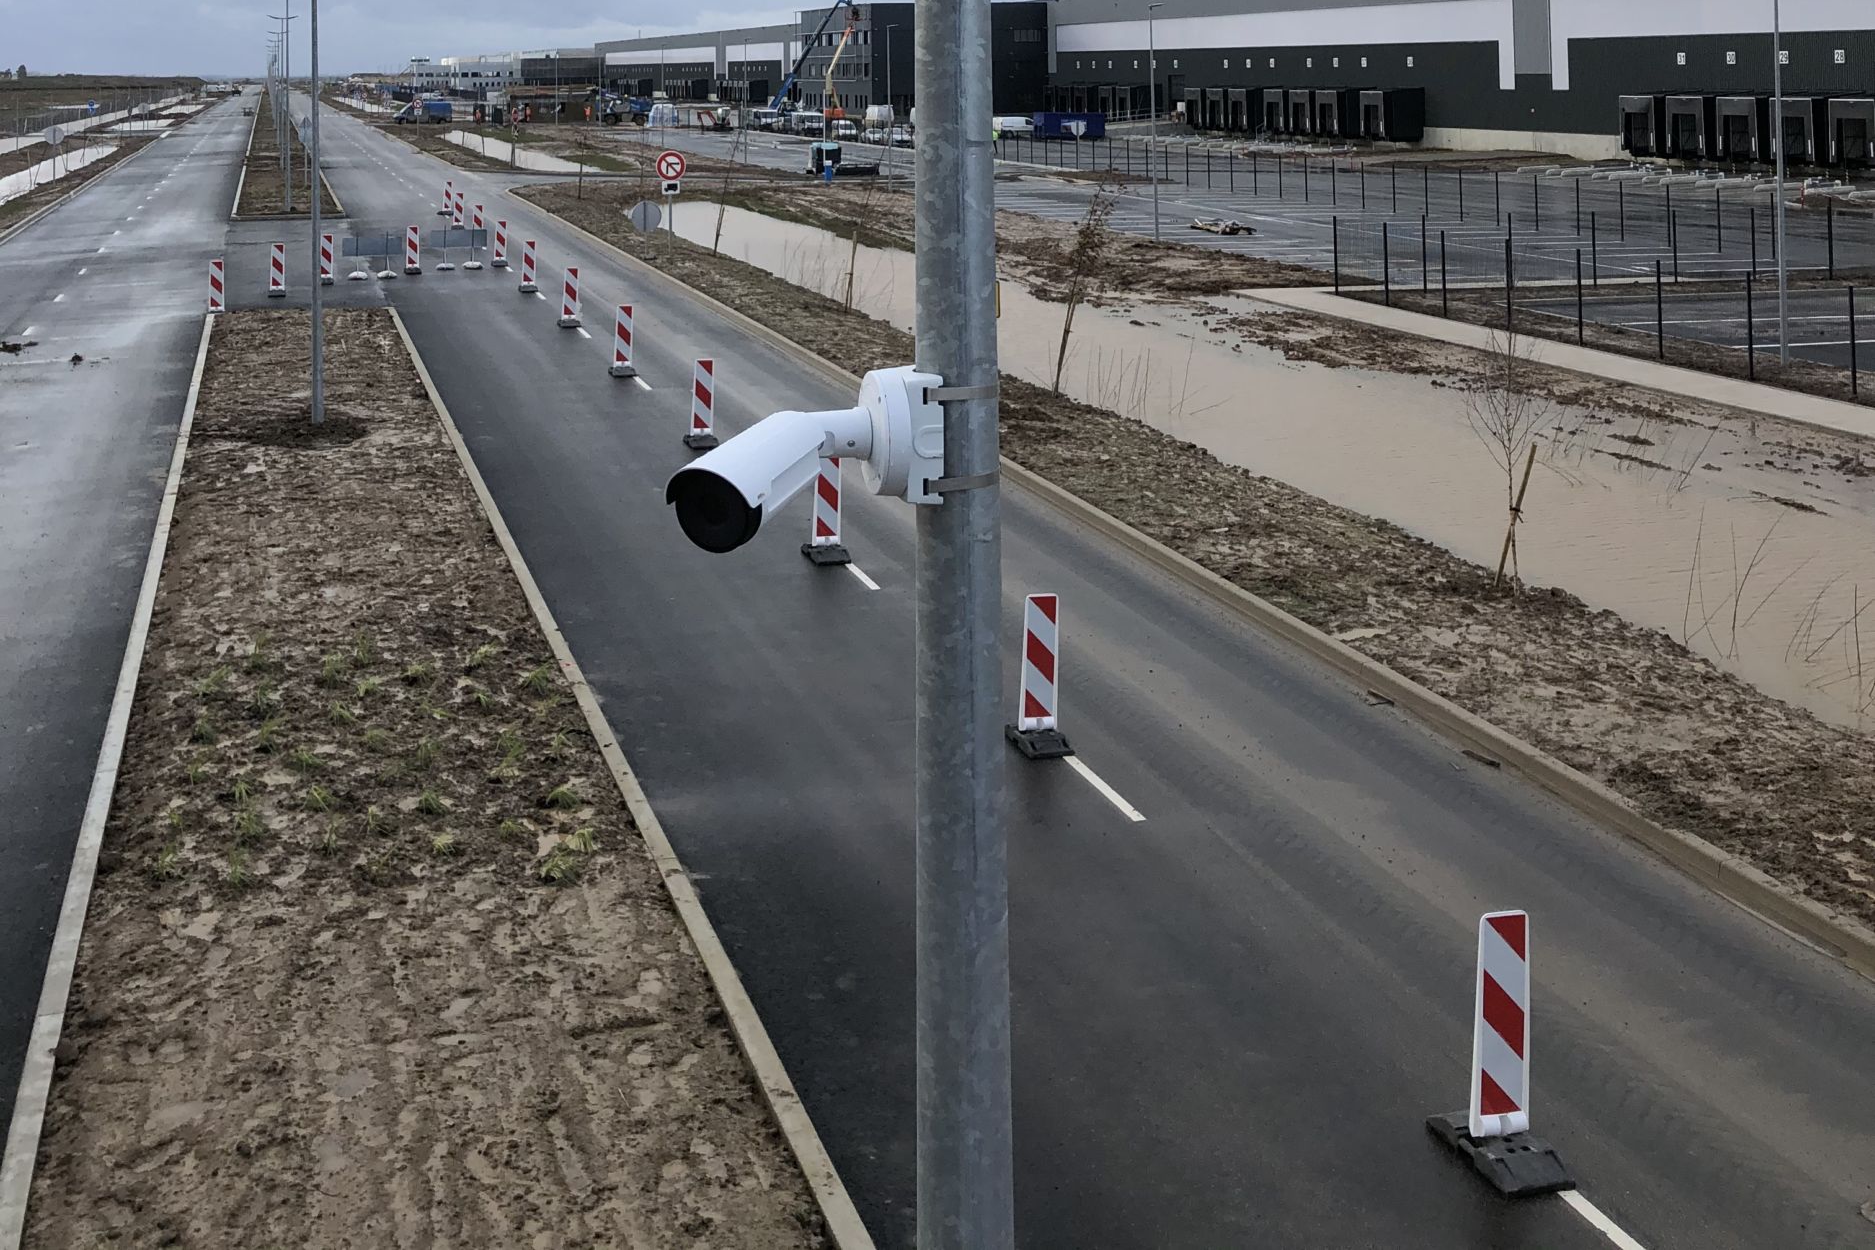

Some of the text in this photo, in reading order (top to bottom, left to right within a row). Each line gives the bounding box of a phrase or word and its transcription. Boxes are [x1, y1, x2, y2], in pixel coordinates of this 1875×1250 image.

[1678, 53, 1686, 64] 31
[1780, 52, 1788, 63] 29
[1835, 51, 1844, 62] 28
